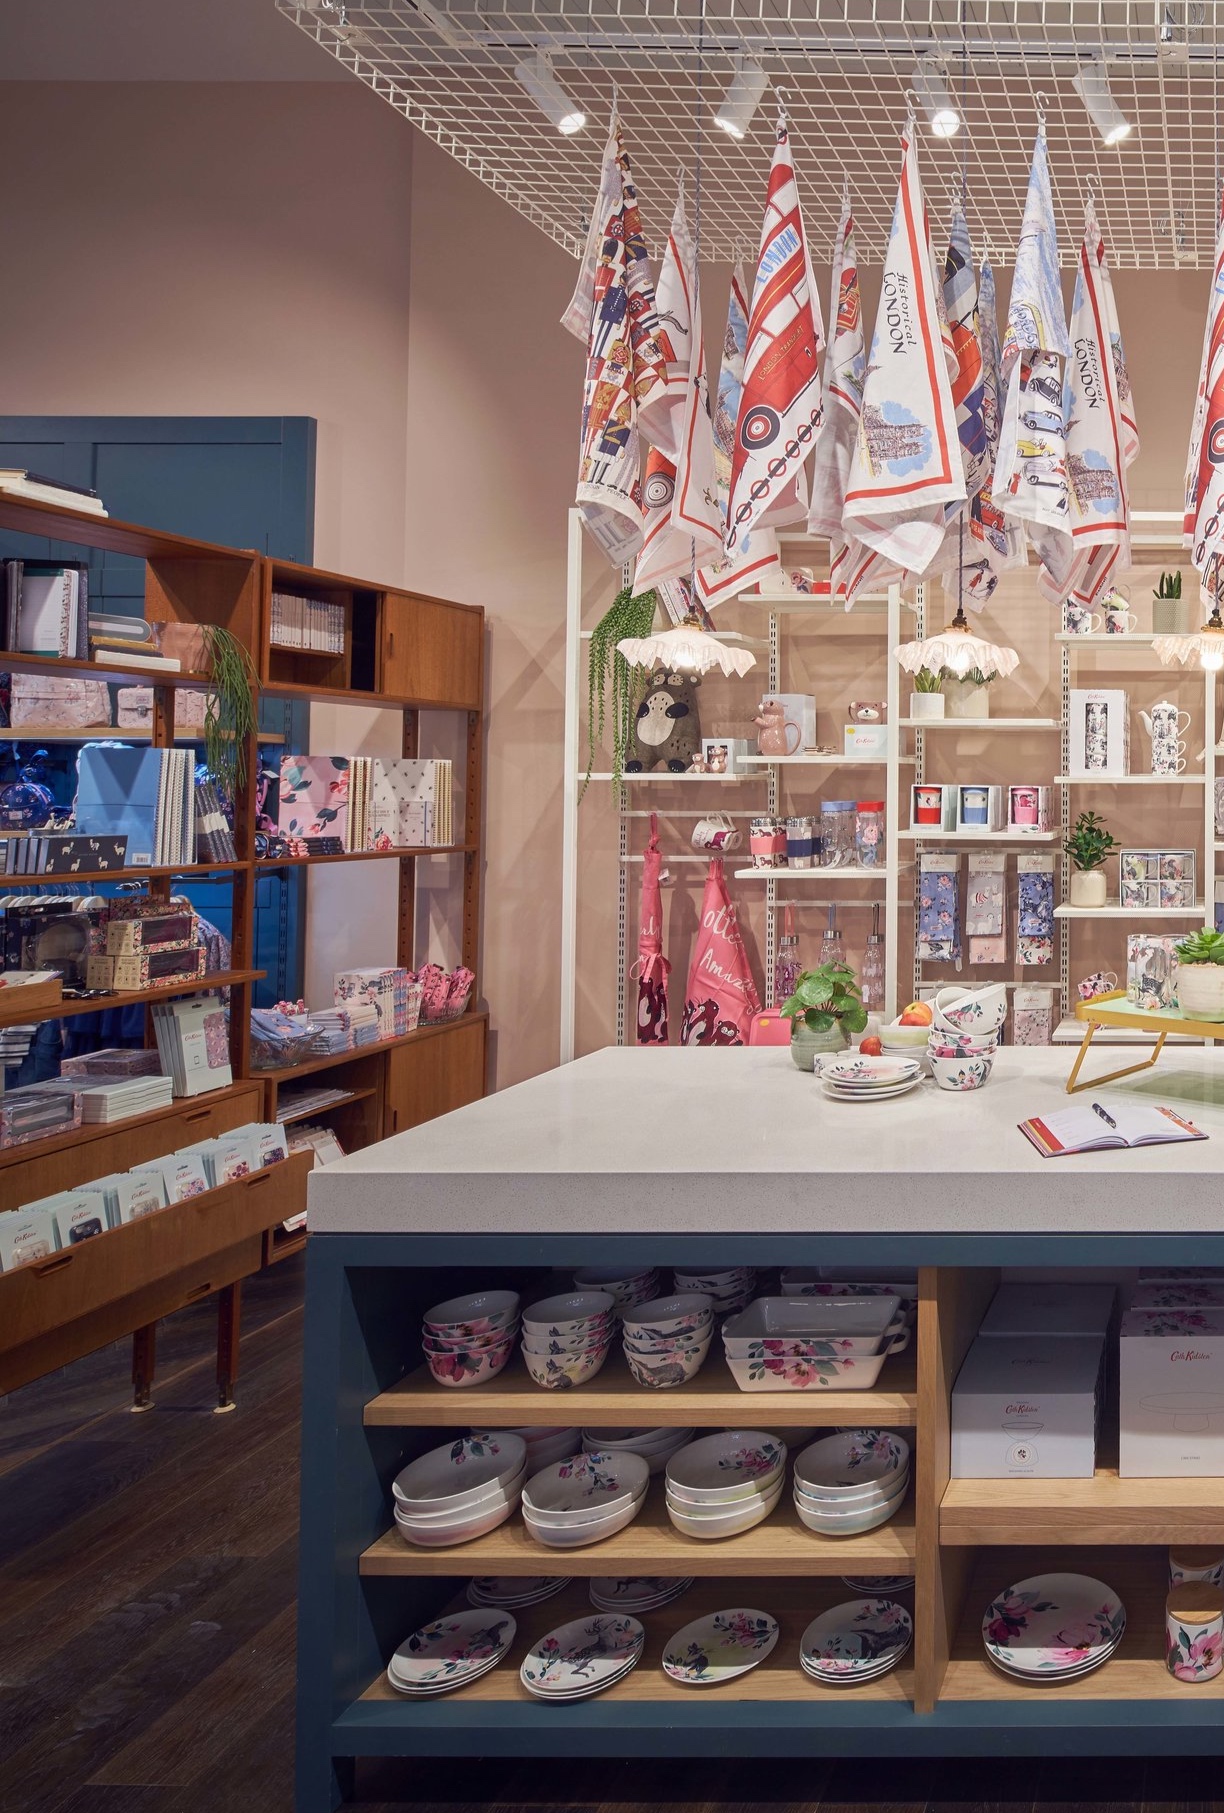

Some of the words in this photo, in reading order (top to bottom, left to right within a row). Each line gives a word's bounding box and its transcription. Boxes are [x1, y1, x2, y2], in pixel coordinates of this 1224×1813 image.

[756, 228, 798, 283] LONDON
[883, 272, 907, 355] LONDON
[896, 272, 917, 345] Historical
[1074, 338, 1100, 409] LONDON
